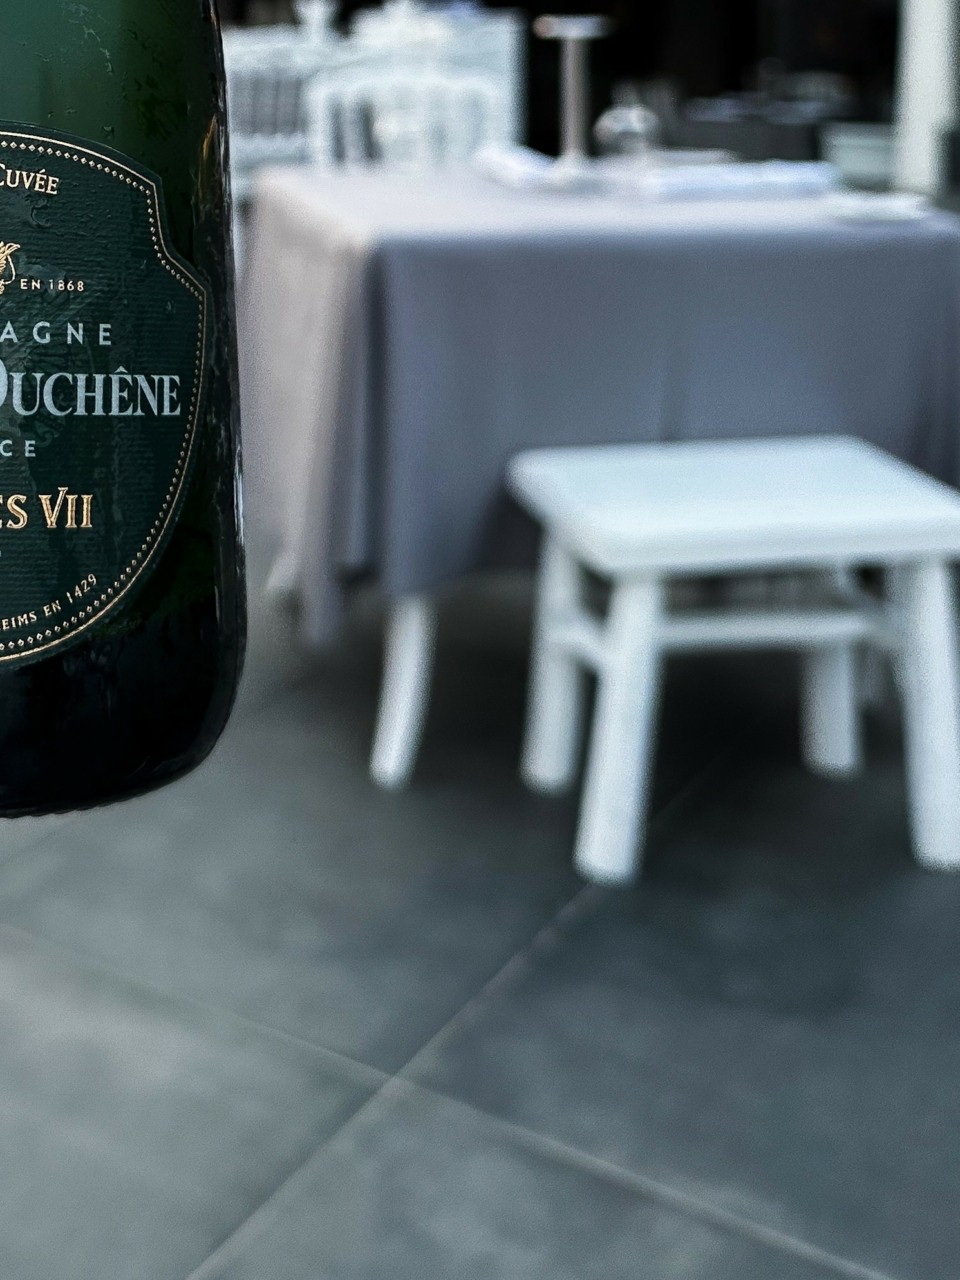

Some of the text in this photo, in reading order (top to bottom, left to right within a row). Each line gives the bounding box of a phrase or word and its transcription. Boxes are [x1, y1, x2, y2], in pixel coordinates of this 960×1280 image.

[20, 278, 41, 290] EN
[48, 279, 85, 292] 1868
[37, 486, 94, 529] VII
[43, 600, 62, 617] EN
[66, 573, 98, 604] 1429
